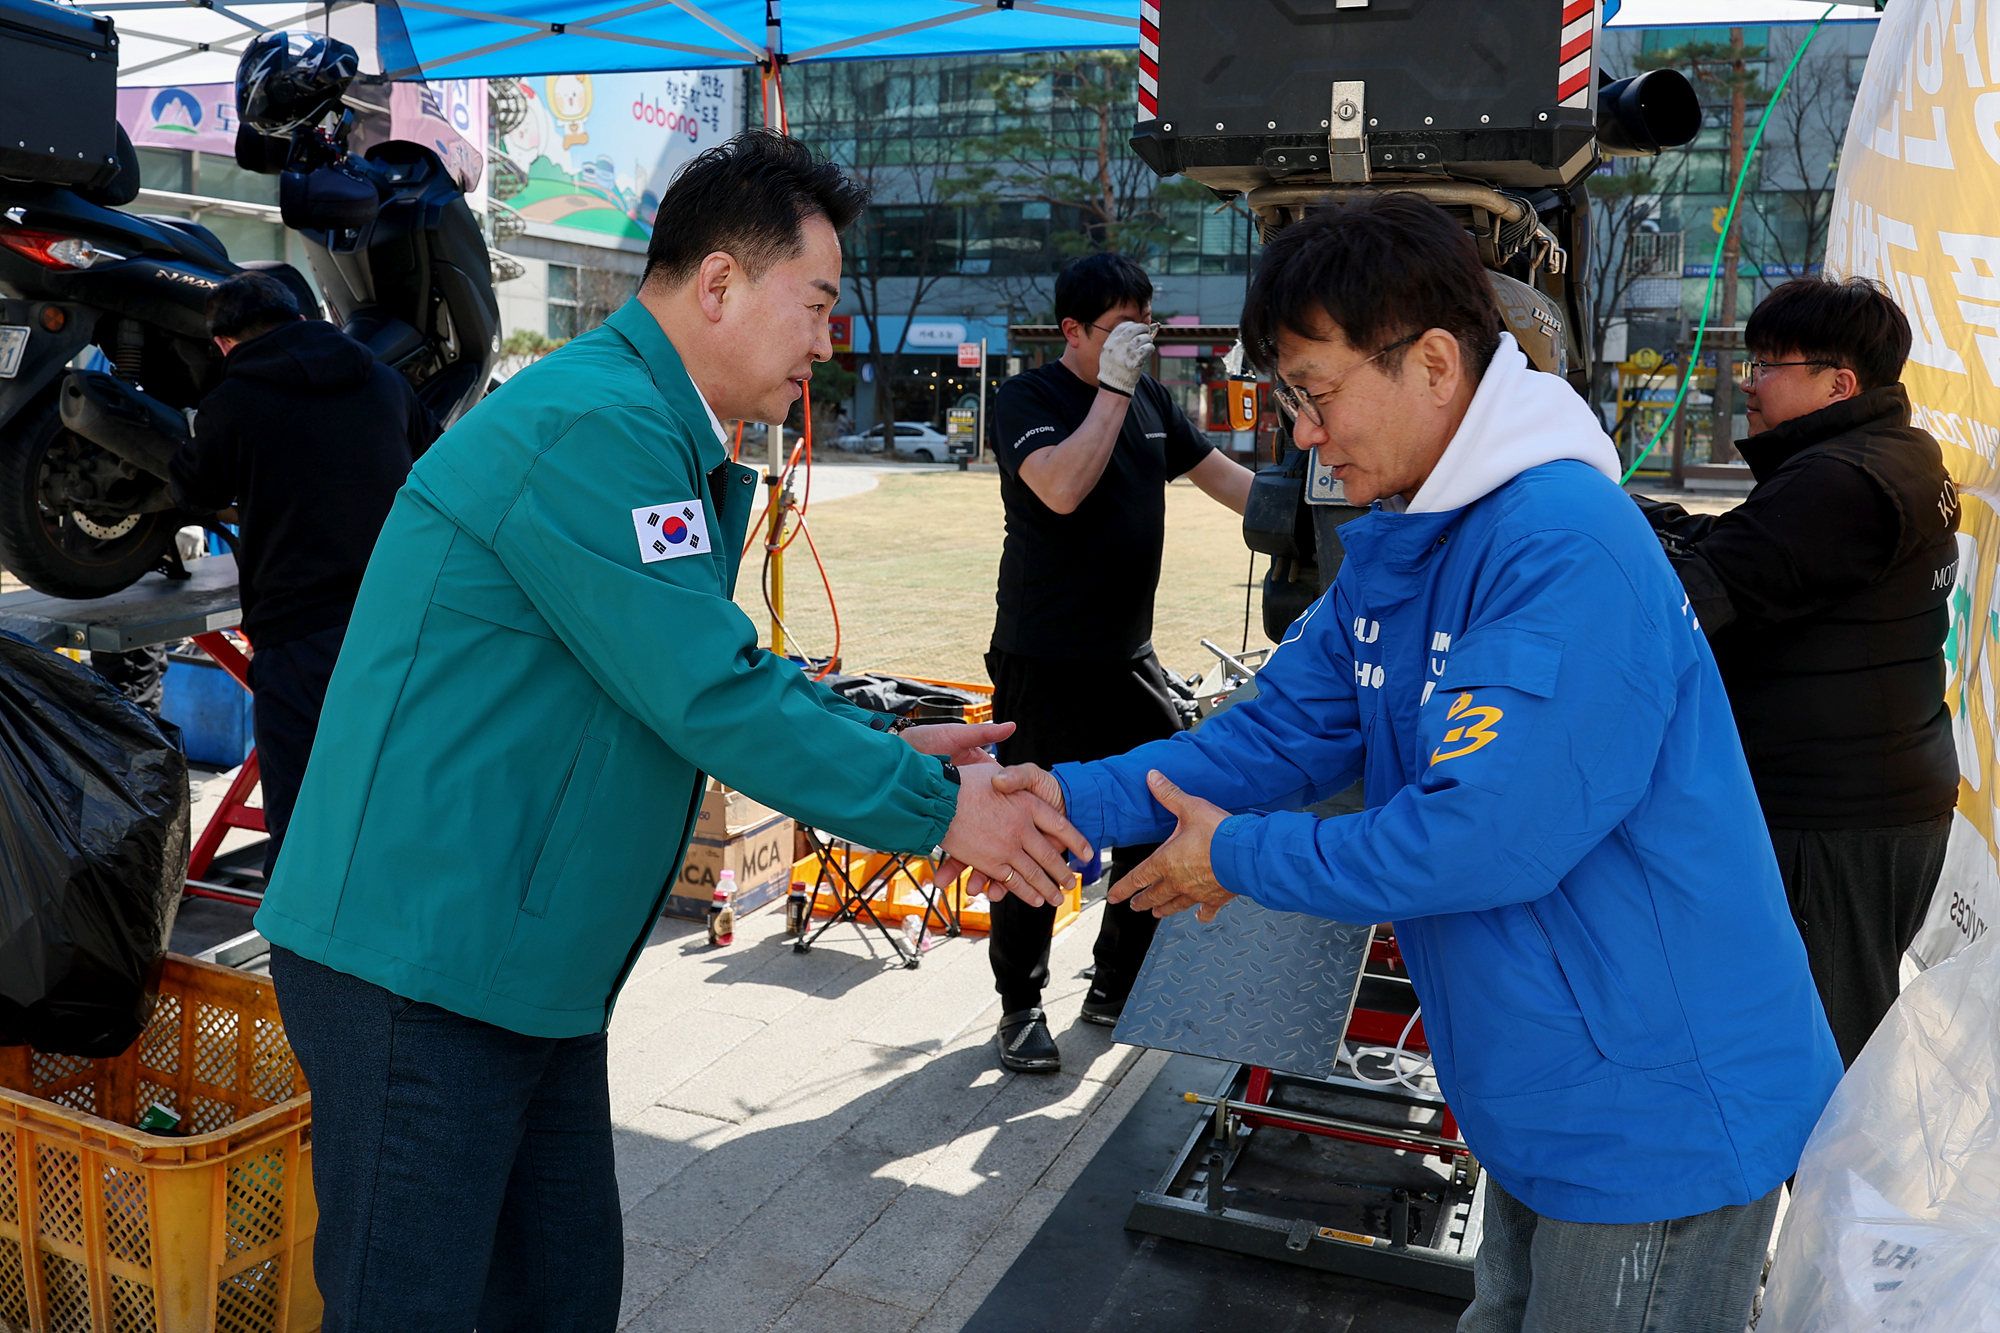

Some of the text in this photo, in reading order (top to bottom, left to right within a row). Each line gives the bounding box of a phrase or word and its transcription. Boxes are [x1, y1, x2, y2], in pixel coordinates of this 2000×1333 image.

[632, 92, 699, 143] dobong
[666, 77, 720, 133] 행복한 도봉
[155, 269, 219, 290] NMAX
[1025, 425, 1056, 439] MOTORS
[741, 840, 781, 882] MCA
